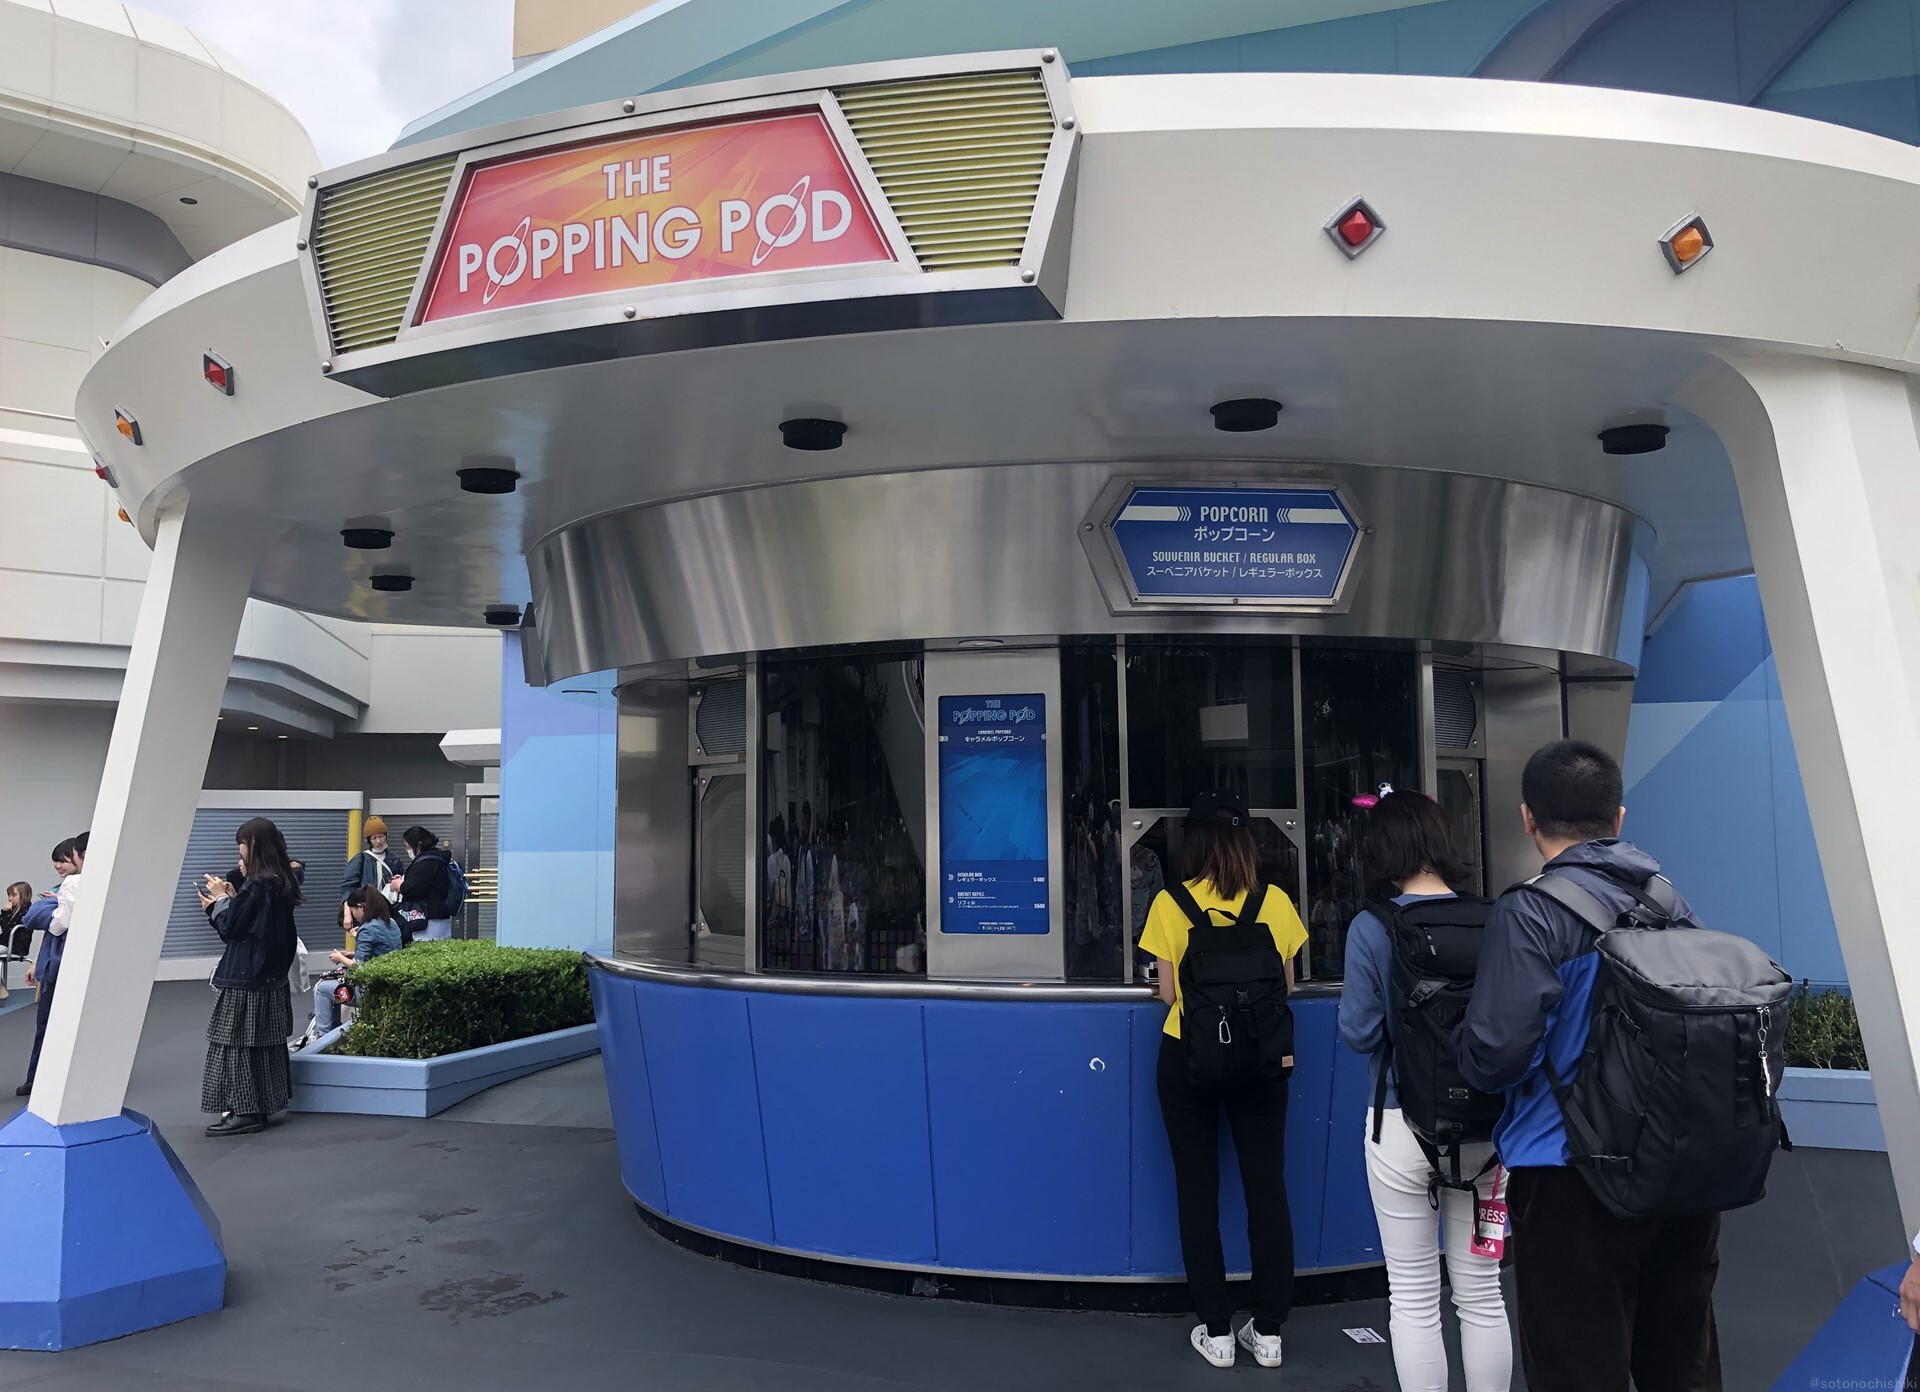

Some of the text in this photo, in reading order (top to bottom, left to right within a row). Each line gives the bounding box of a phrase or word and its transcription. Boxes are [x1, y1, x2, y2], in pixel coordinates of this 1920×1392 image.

[603, 154, 671, 200] THE
[459, 175, 852, 305] POPPING POD
[1200, 506, 1268, 523] POPCORN
[1194, 526, 1275, 542] ポップコーン
[1152, 551, 1201, 562] SOUVENIR
[1203, 552, 1240, 563] BUCKET
[1250, 552, 1294, 564] REGULAR
[1296, 553, 1316, 564] BOX
[1147, 566, 1229, 578] スーベニアバケット
[1239, 567, 1322, 579] レギュラーボックス
[985, 699, 1001, 708] THE
[953, 706, 1036, 725] POPPING POD
[1479, 1207, 1505, 1223] RESS
